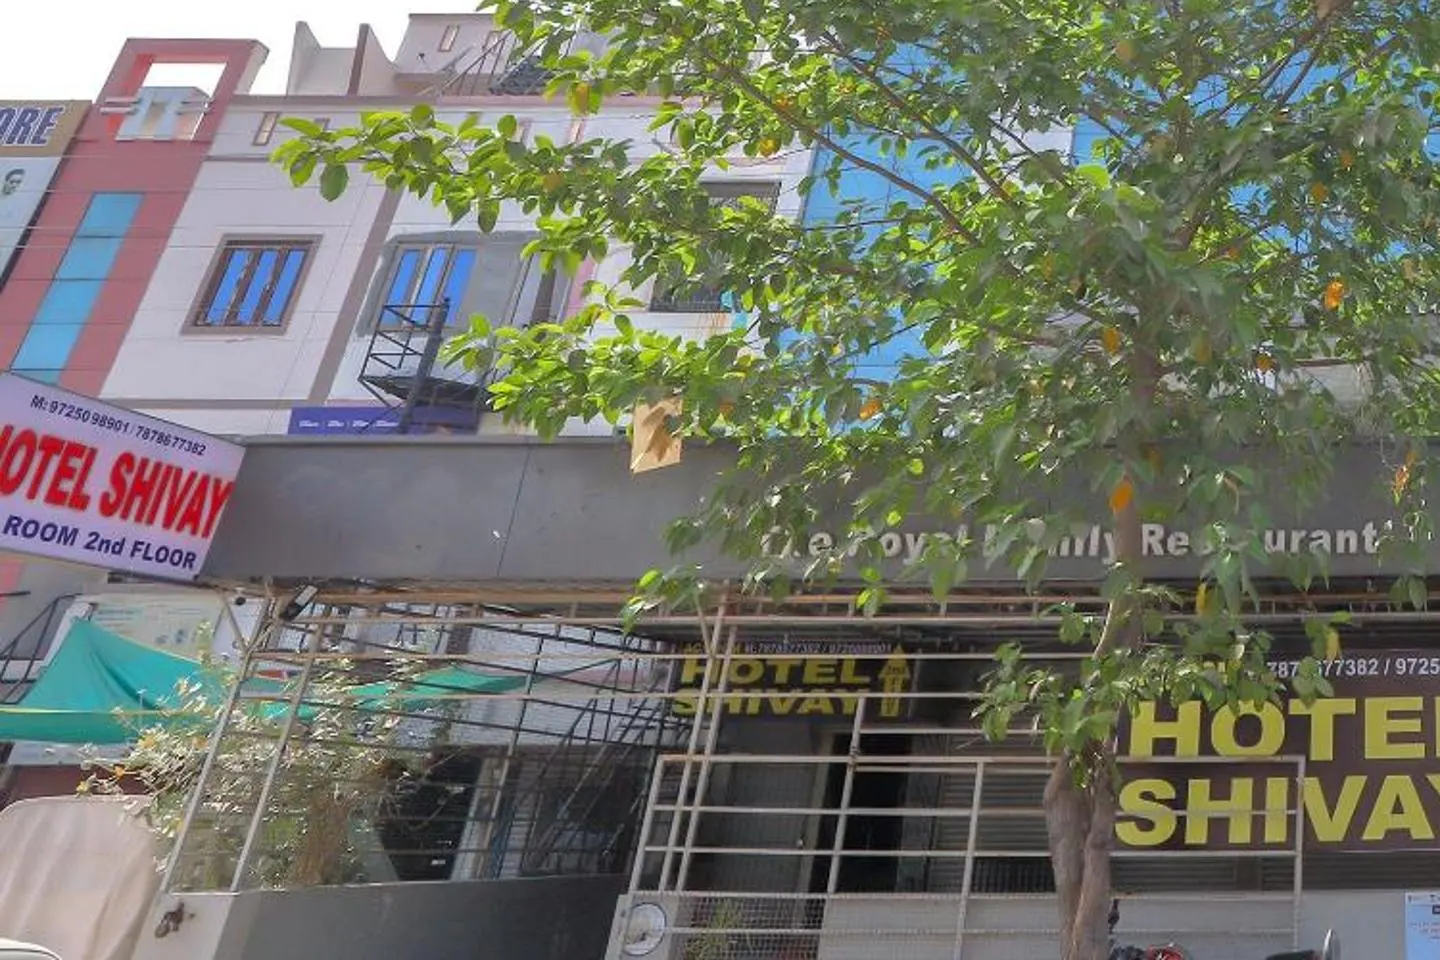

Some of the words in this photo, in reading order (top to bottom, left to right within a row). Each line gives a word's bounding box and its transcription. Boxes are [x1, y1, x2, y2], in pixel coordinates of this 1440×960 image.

[99, 450, 236, 539] SHIVAY
[3, 514, 79, 547] ROOM
[83, 531, 126, 556] 2nd
[130, 540, 198, 570] FLOOR
[1141, 521, 1379, 556] Reurant
